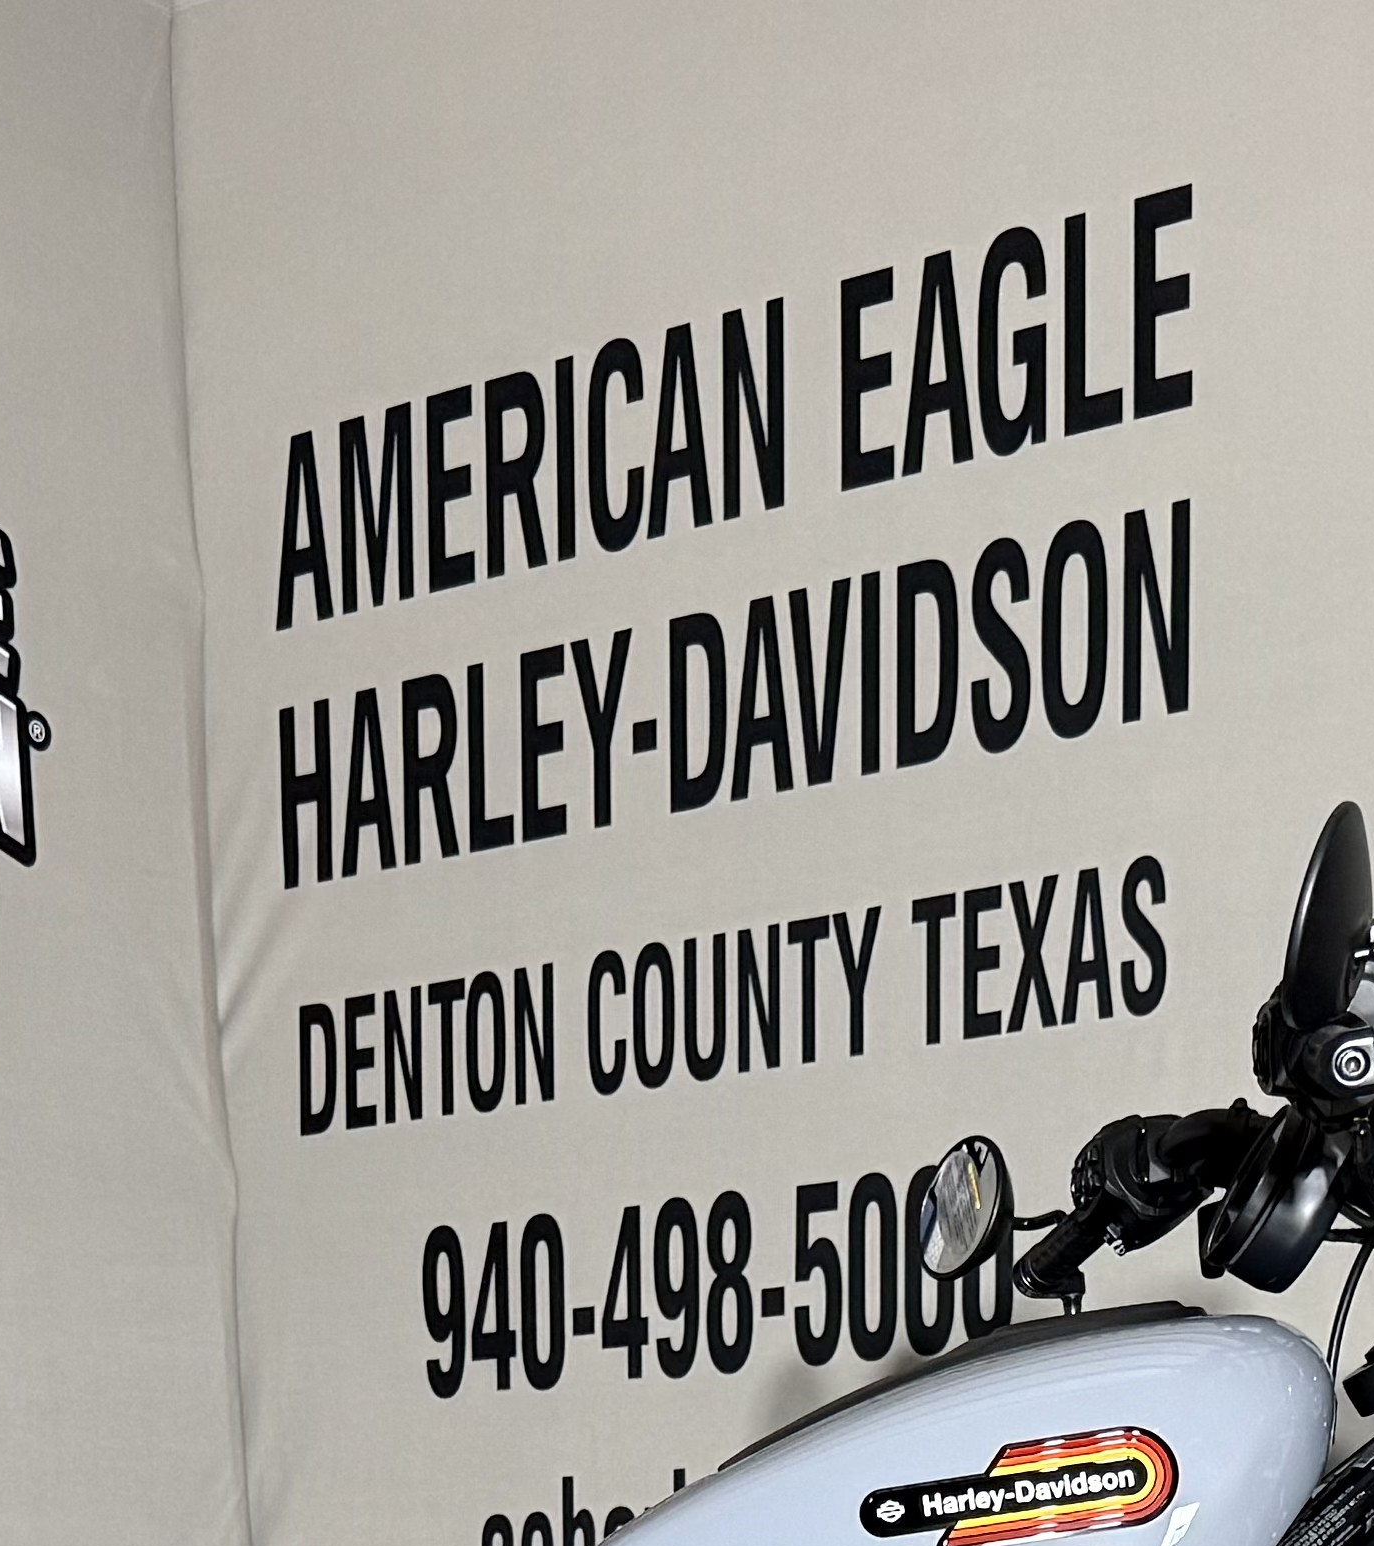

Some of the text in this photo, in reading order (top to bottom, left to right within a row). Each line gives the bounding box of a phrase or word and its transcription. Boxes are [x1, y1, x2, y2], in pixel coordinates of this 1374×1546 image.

[276, 182, 1194, 631] AMERICAN EAGLE
[277, 498, 1192, 891] HARLEY-DAVIDSON
[299, 854, 1167, 1137] DENTON COUNTY TEXAS
[922, 1468, 1136, 1518] Harley-Davidson
